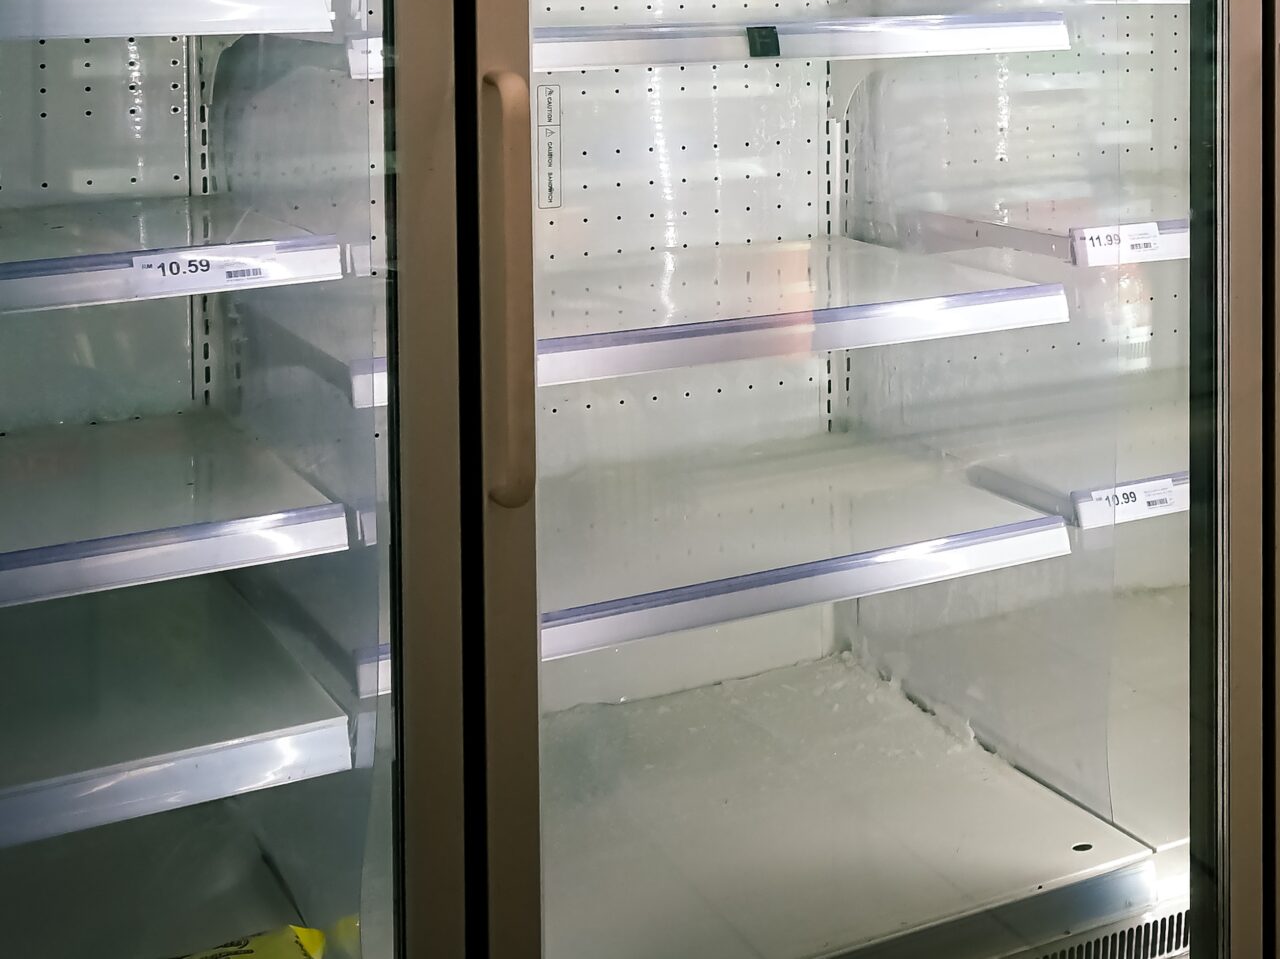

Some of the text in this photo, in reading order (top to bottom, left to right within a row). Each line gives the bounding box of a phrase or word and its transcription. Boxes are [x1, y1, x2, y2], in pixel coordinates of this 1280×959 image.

[1088, 233, 1122, 248] 11.99
[157, 259, 211, 277] 10.59
[1105, 491, 1137, 507] 10.99
